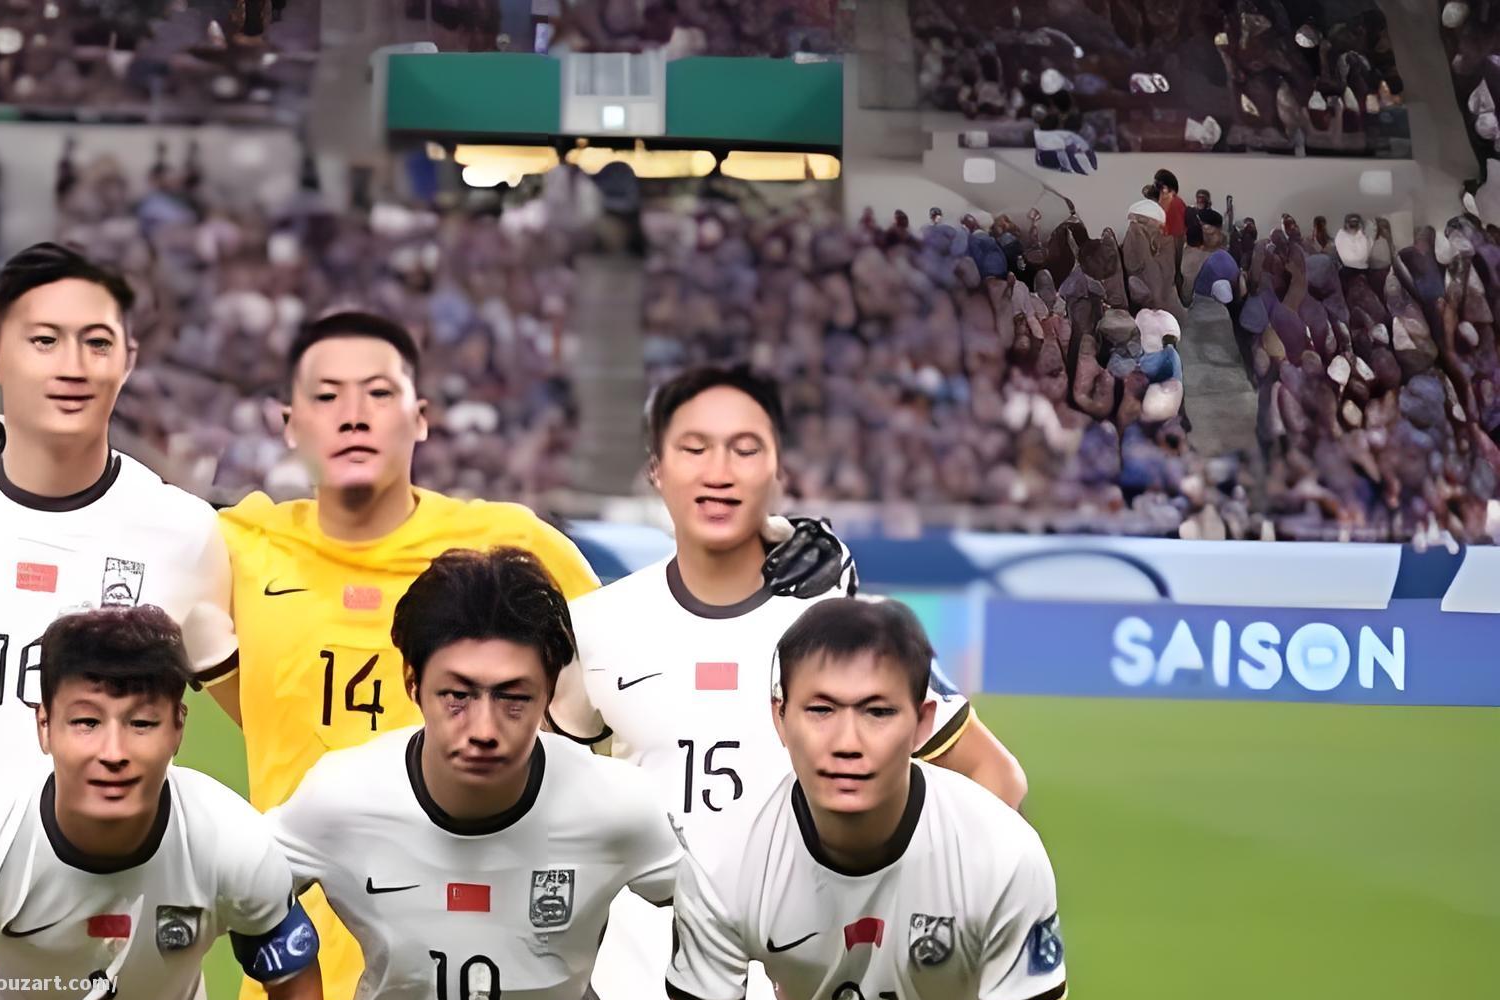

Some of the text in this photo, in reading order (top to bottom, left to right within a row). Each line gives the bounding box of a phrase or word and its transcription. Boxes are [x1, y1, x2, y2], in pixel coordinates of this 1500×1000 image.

[320, 650, 384, 731] 14
[1110, 616, 1405, 691] SAISON
[678, 739, 743, 813] 15
